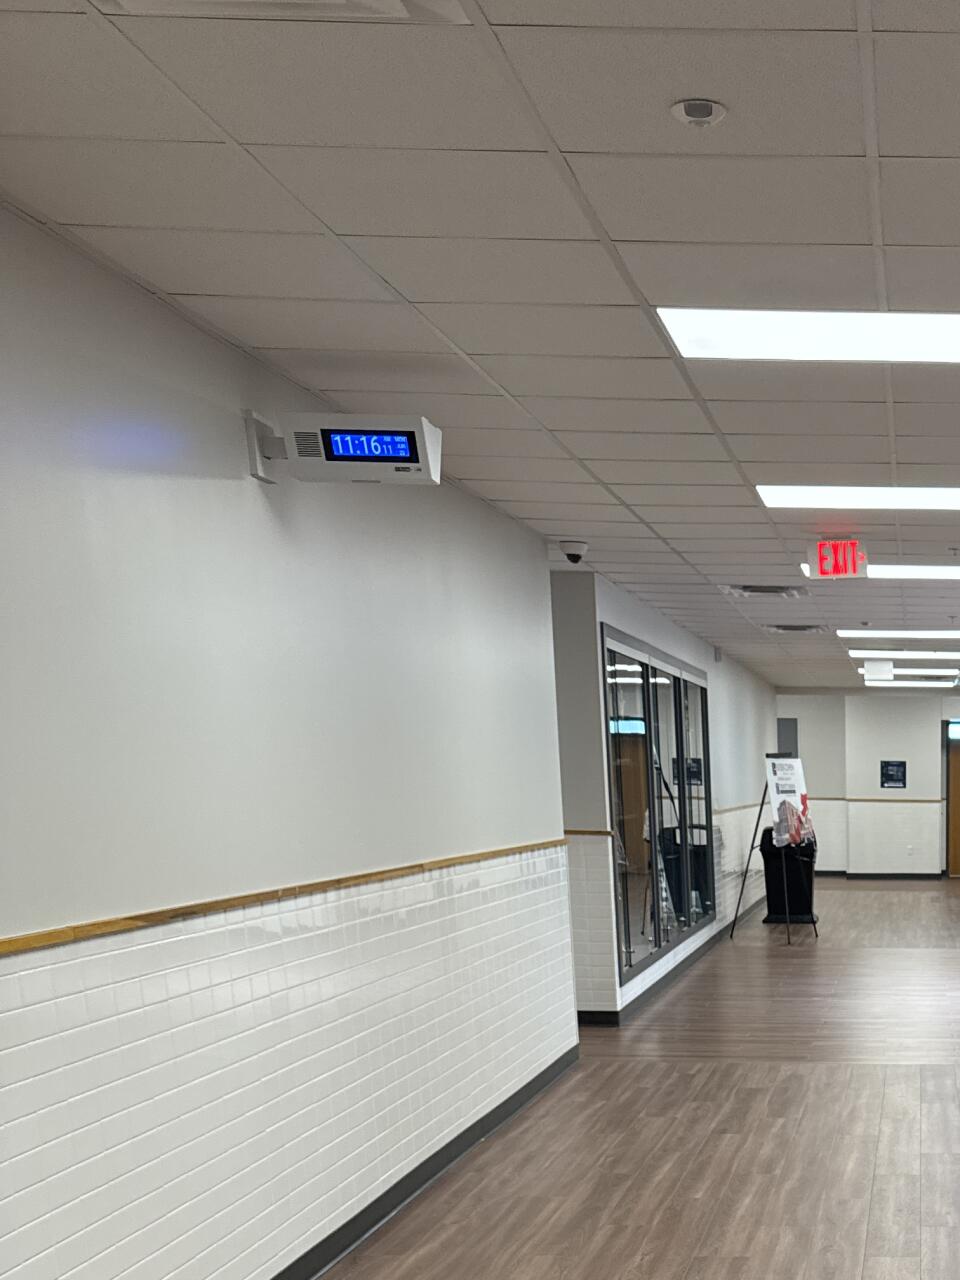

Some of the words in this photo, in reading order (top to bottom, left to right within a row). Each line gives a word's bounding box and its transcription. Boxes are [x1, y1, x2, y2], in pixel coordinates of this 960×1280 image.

[334, 435, 381, 455] 11:16
[383, 444, 393, 454] 11
[817, 540, 859, 576] EXIT
